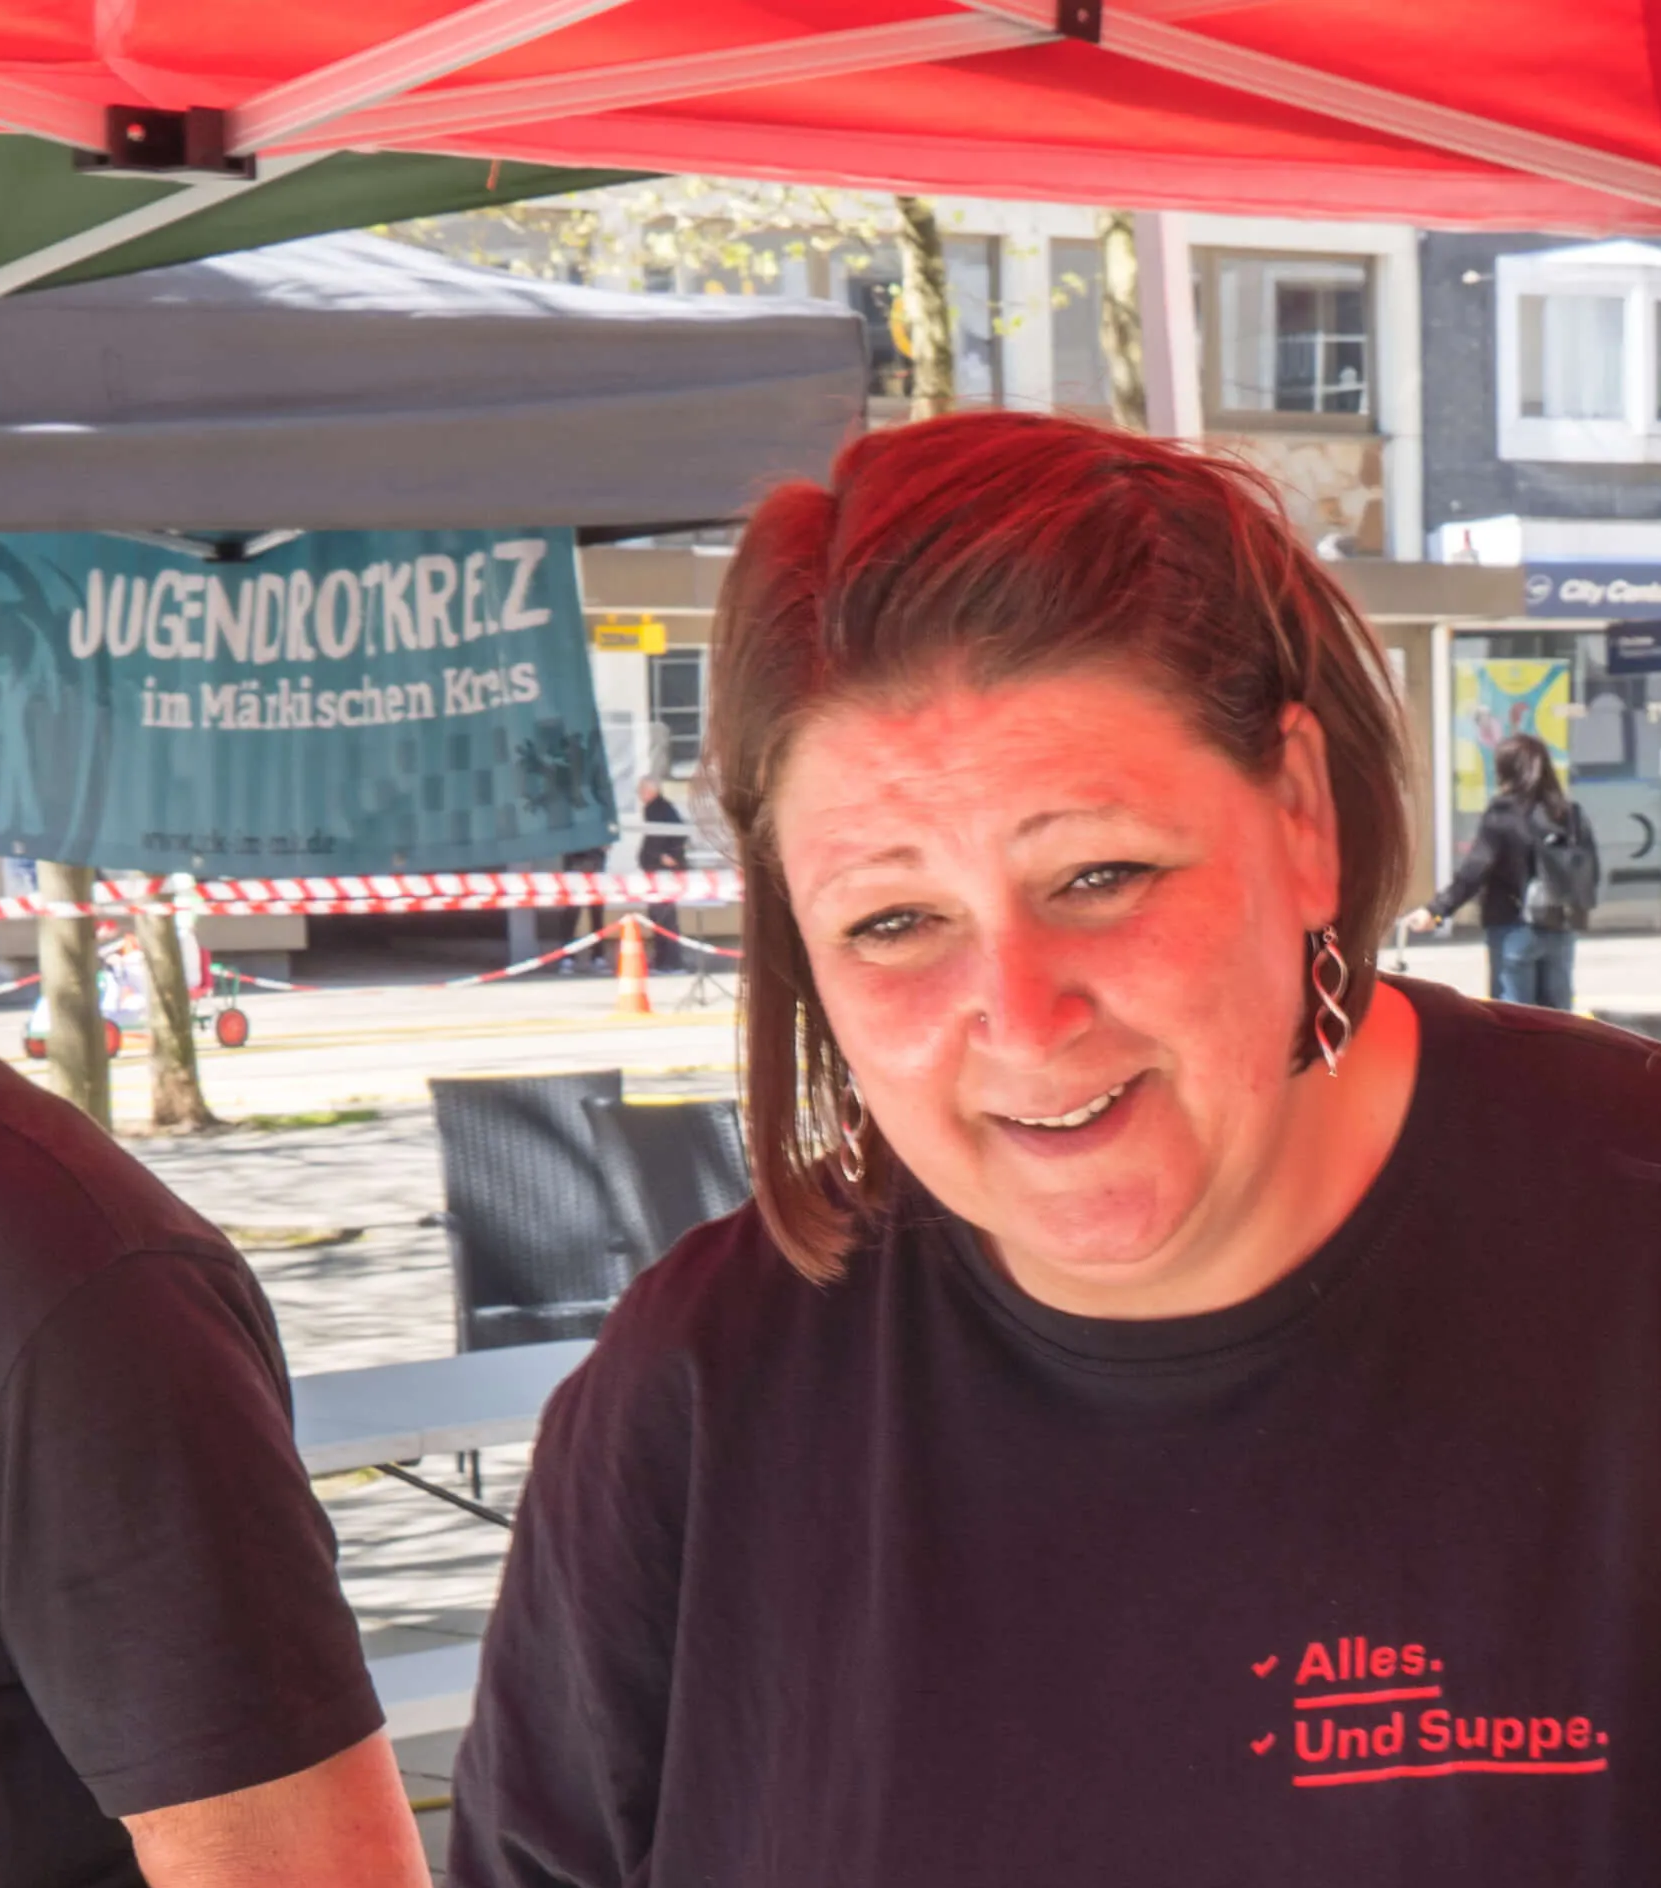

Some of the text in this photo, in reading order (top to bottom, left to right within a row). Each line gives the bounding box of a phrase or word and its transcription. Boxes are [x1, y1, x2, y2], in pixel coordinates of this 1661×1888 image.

[69, 539, 552, 666] JUGENDROTKREZ
[200, 668, 436, 730] Märkischen
[1294, 1636, 1445, 1686] Alles.
[1293, 1708, 1610, 1763] Und Suppe.
